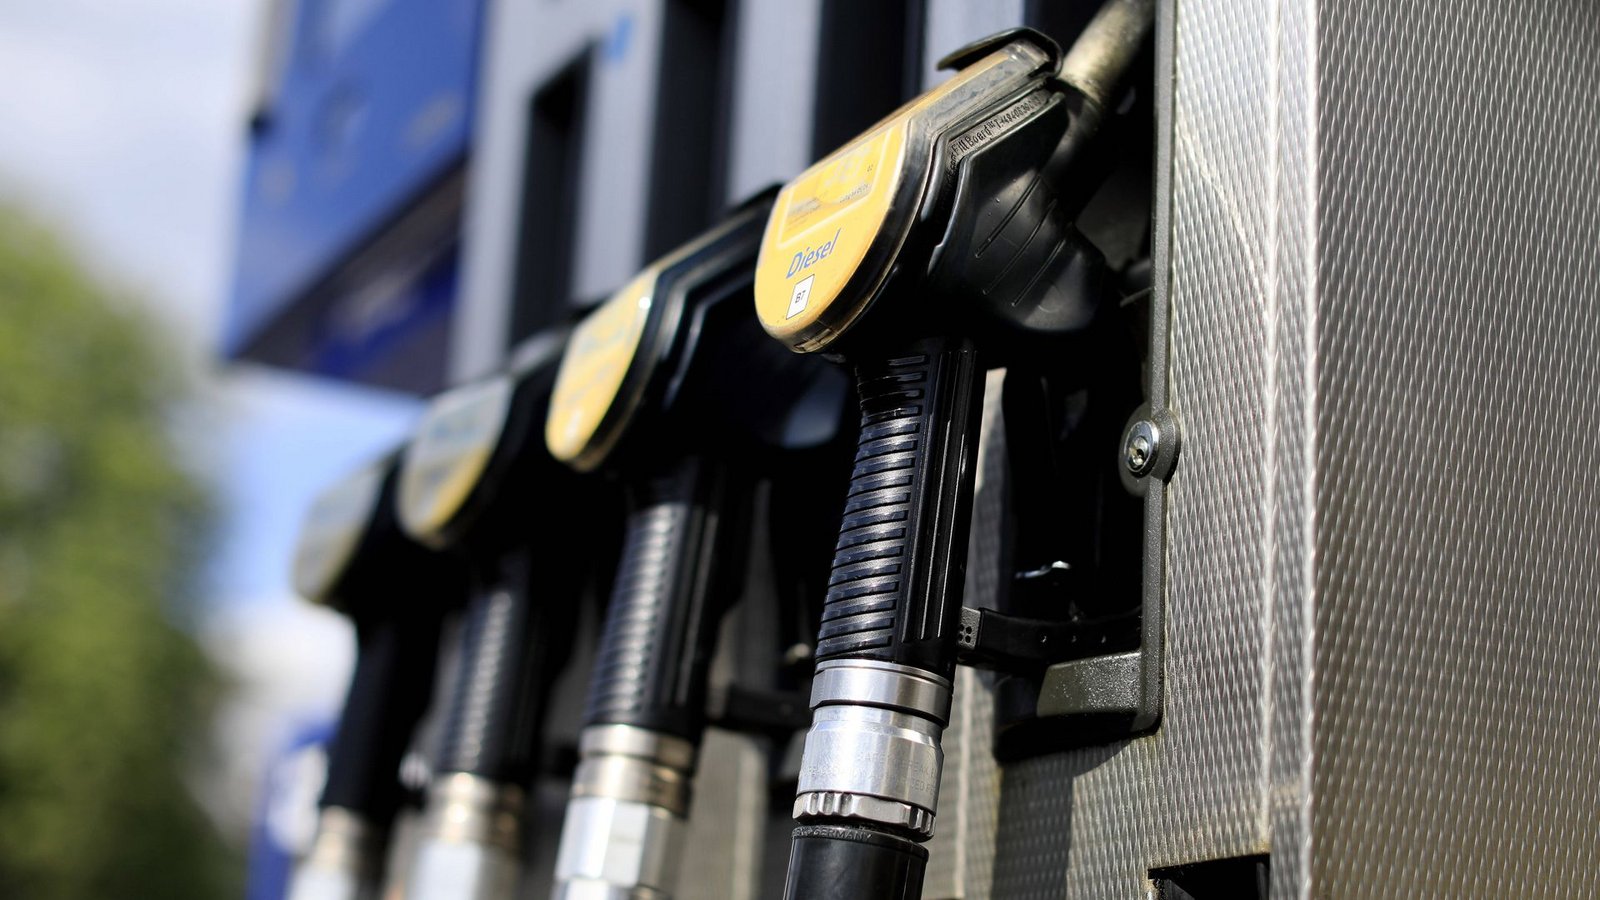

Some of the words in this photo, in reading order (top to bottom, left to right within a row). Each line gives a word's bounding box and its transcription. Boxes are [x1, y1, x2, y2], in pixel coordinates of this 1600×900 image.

[785, 227, 842, 279] Diesel
[795, 289, 806, 304] B7
[813, 826, 872, 842] GERMANY
